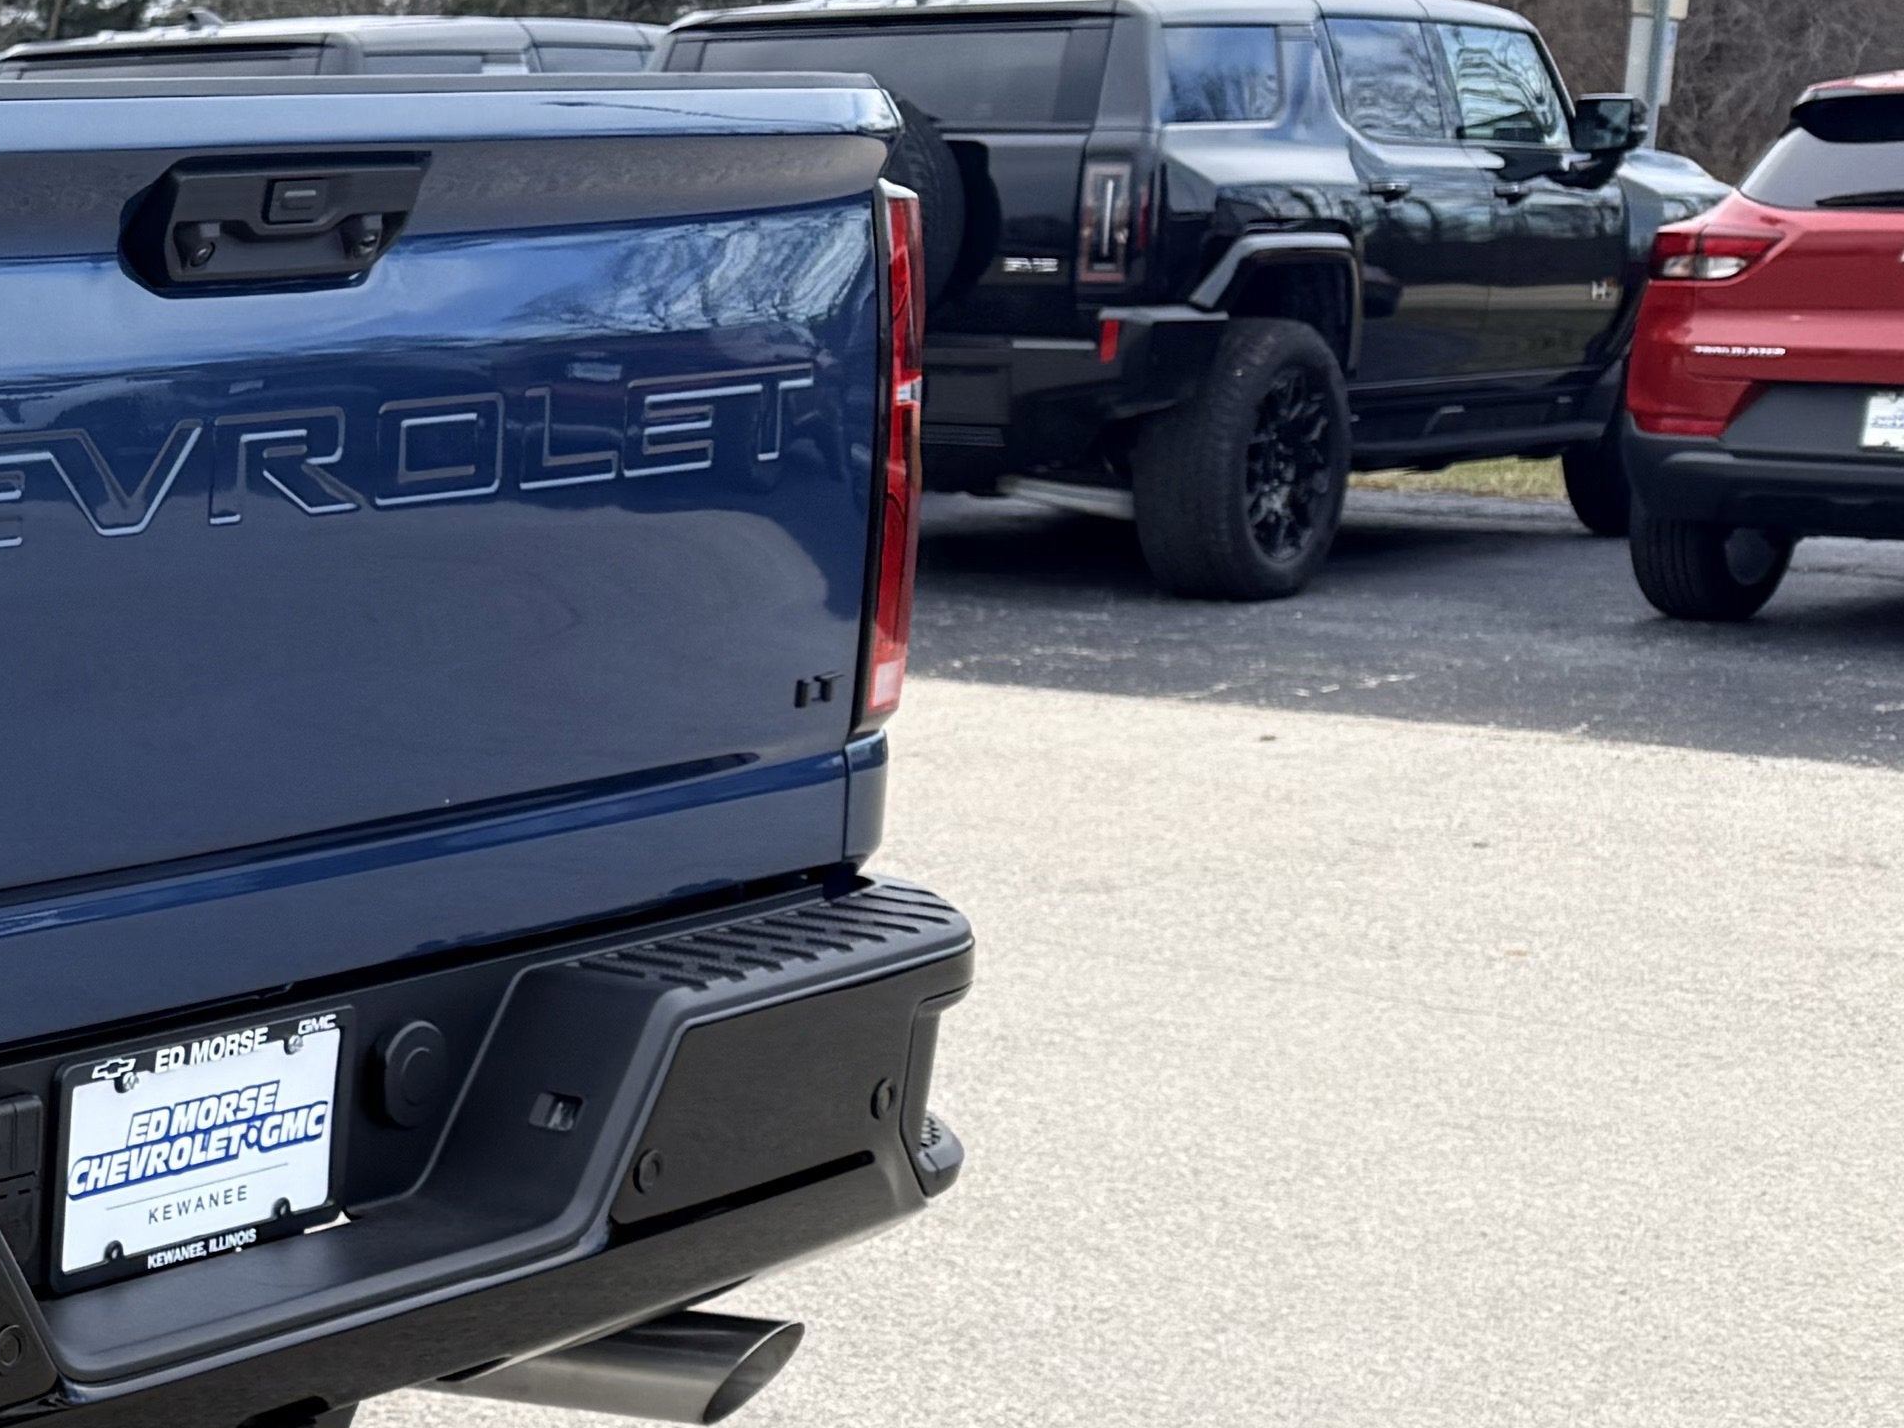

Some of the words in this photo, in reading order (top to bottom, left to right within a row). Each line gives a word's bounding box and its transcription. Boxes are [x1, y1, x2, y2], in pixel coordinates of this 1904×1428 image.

[297, 1013, 337, 1035] GMC
[154, 1046, 186, 1074] ED
[189, 1026, 269, 1066] MORSE
[126, 1108, 173, 1148] ED
[172, 1079, 280, 1137] MORSE
[148, 1184, 248, 1225] KEWANEE
[208, 1227, 257, 1253] ILLINOIS
